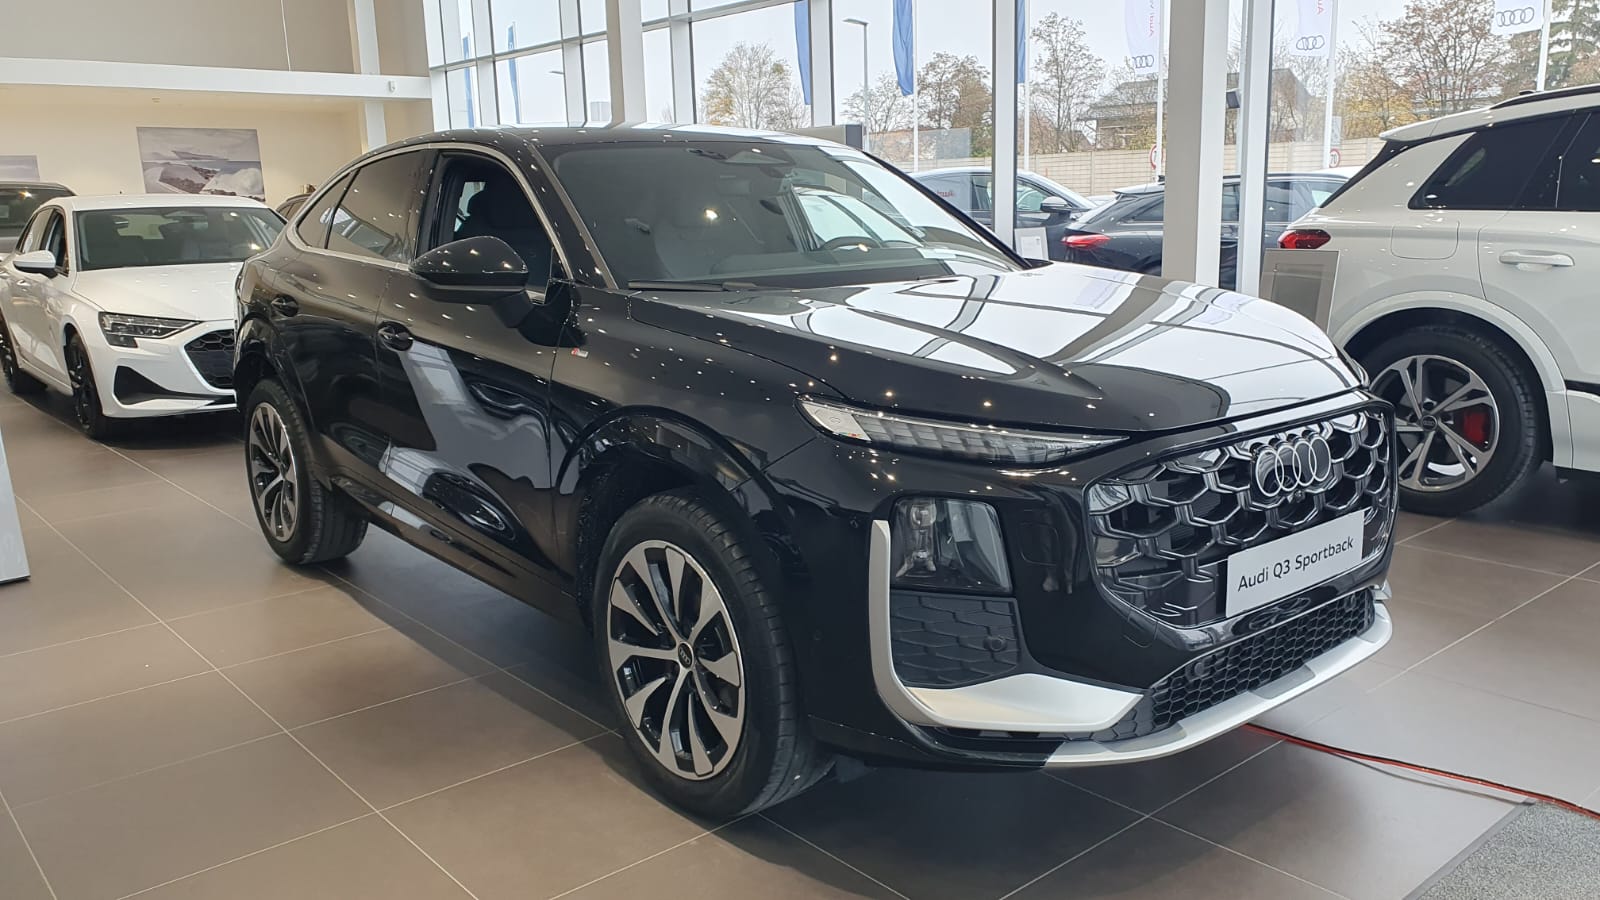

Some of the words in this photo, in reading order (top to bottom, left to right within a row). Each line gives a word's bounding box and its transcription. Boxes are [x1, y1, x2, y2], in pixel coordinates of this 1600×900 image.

[1238, 567, 1269, 592] Audi
[1273, 559, 1291, 578] Q3
[1295, 536, 1354, 571] Sportback
